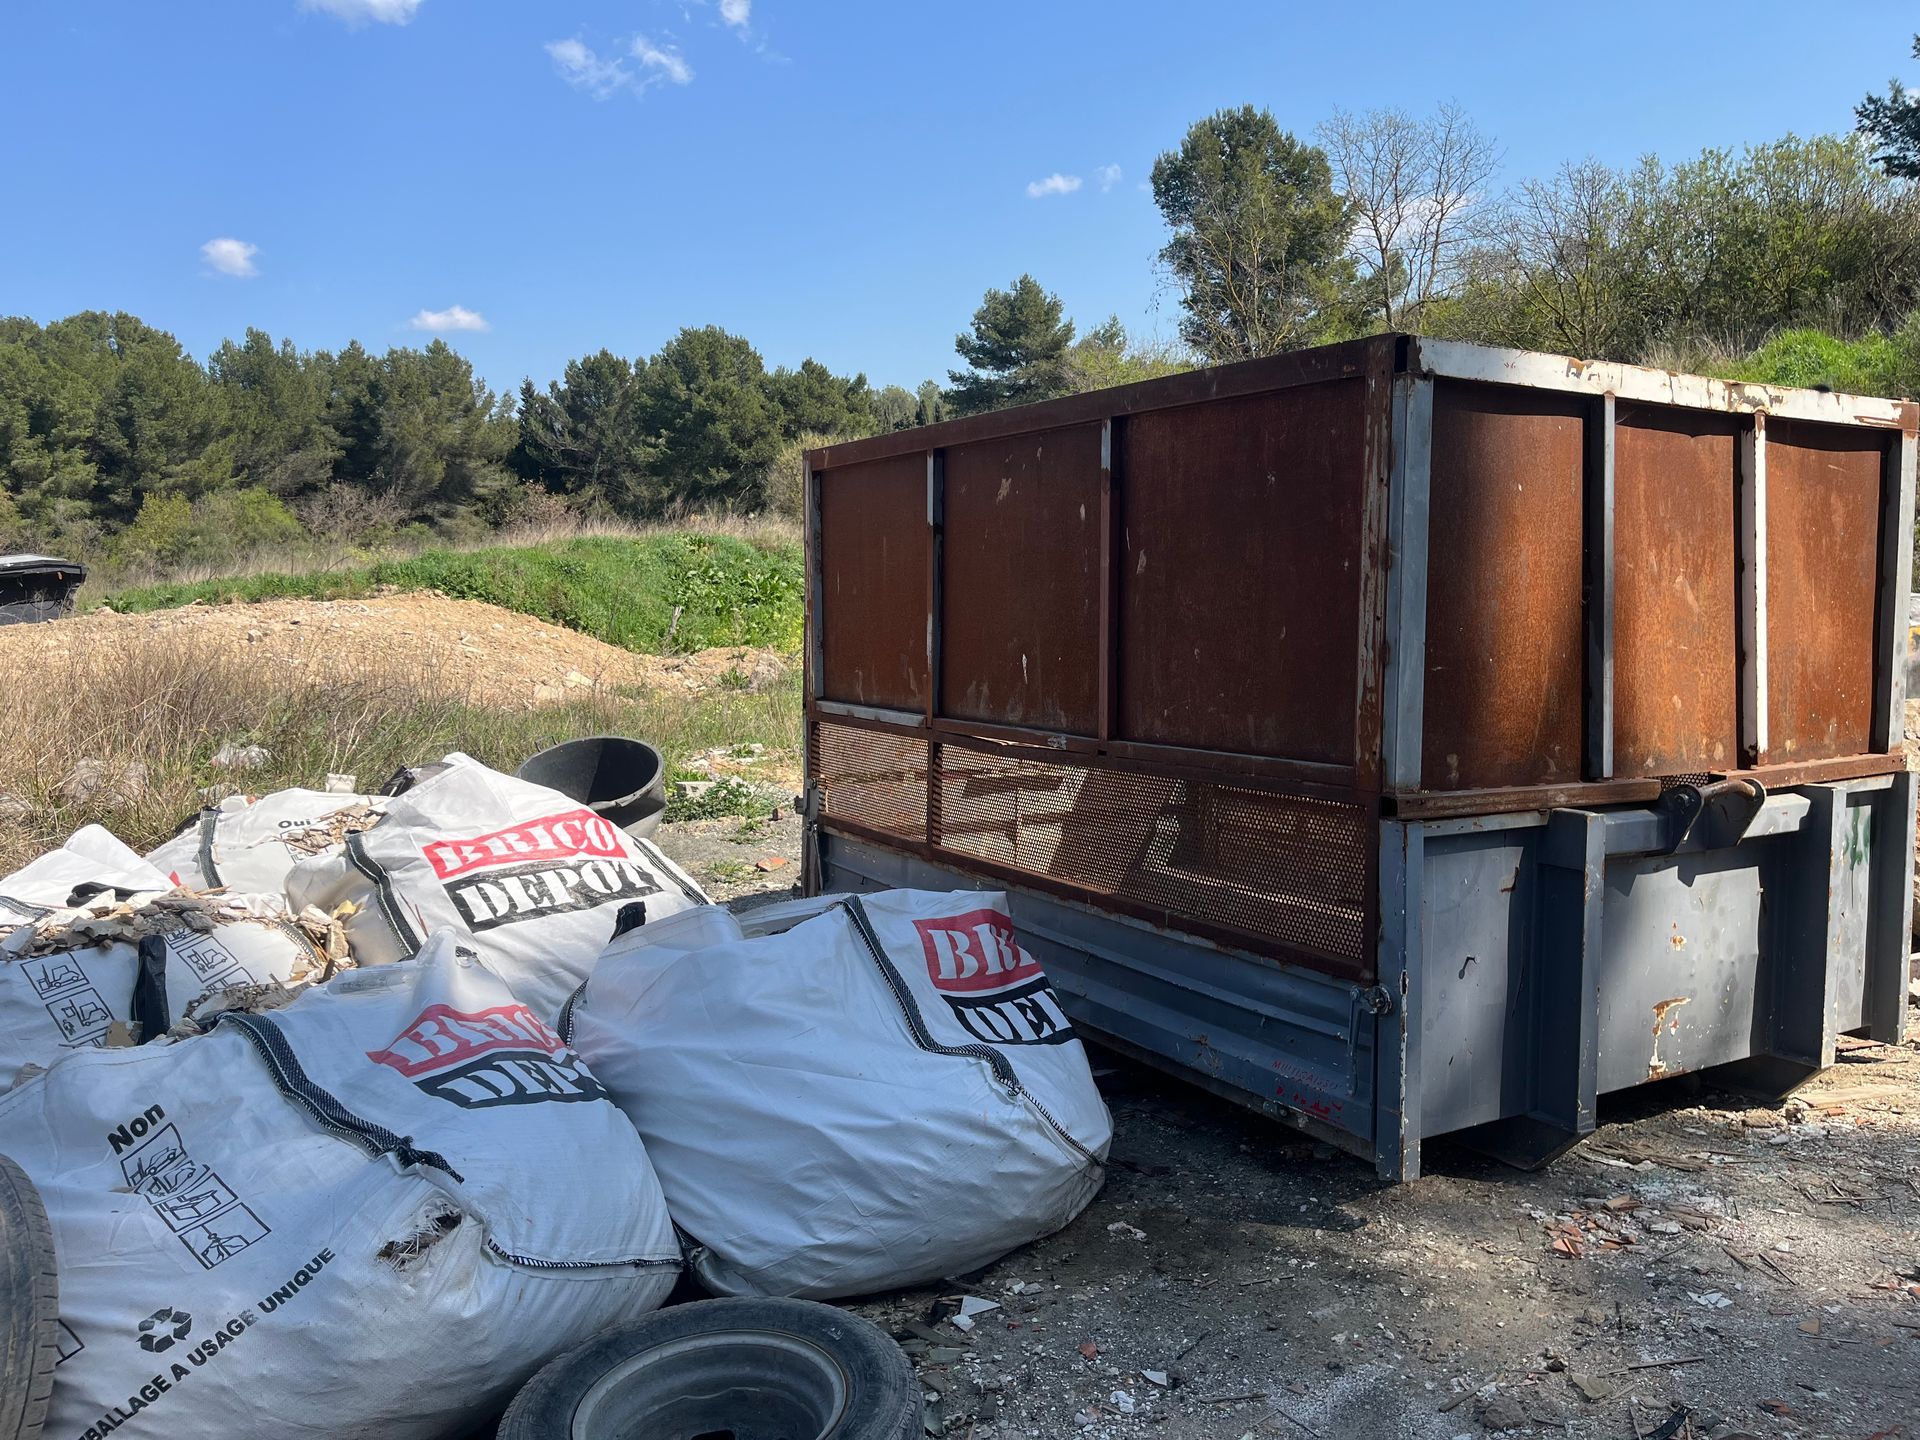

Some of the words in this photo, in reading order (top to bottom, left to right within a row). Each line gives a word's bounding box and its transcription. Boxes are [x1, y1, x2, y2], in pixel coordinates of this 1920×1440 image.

[278, 818, 311, 829] Oui
[435, 818, 615, 872] BRICO
[107, 1104, 165, 1155] Non
[77, 1374, 172, 1440] BALLAGE
[170, 1362, 191, 1382] A
[186, 1309, 259, 1367] USAGE
[257, 1247, 336, 1313] UNIQUE
